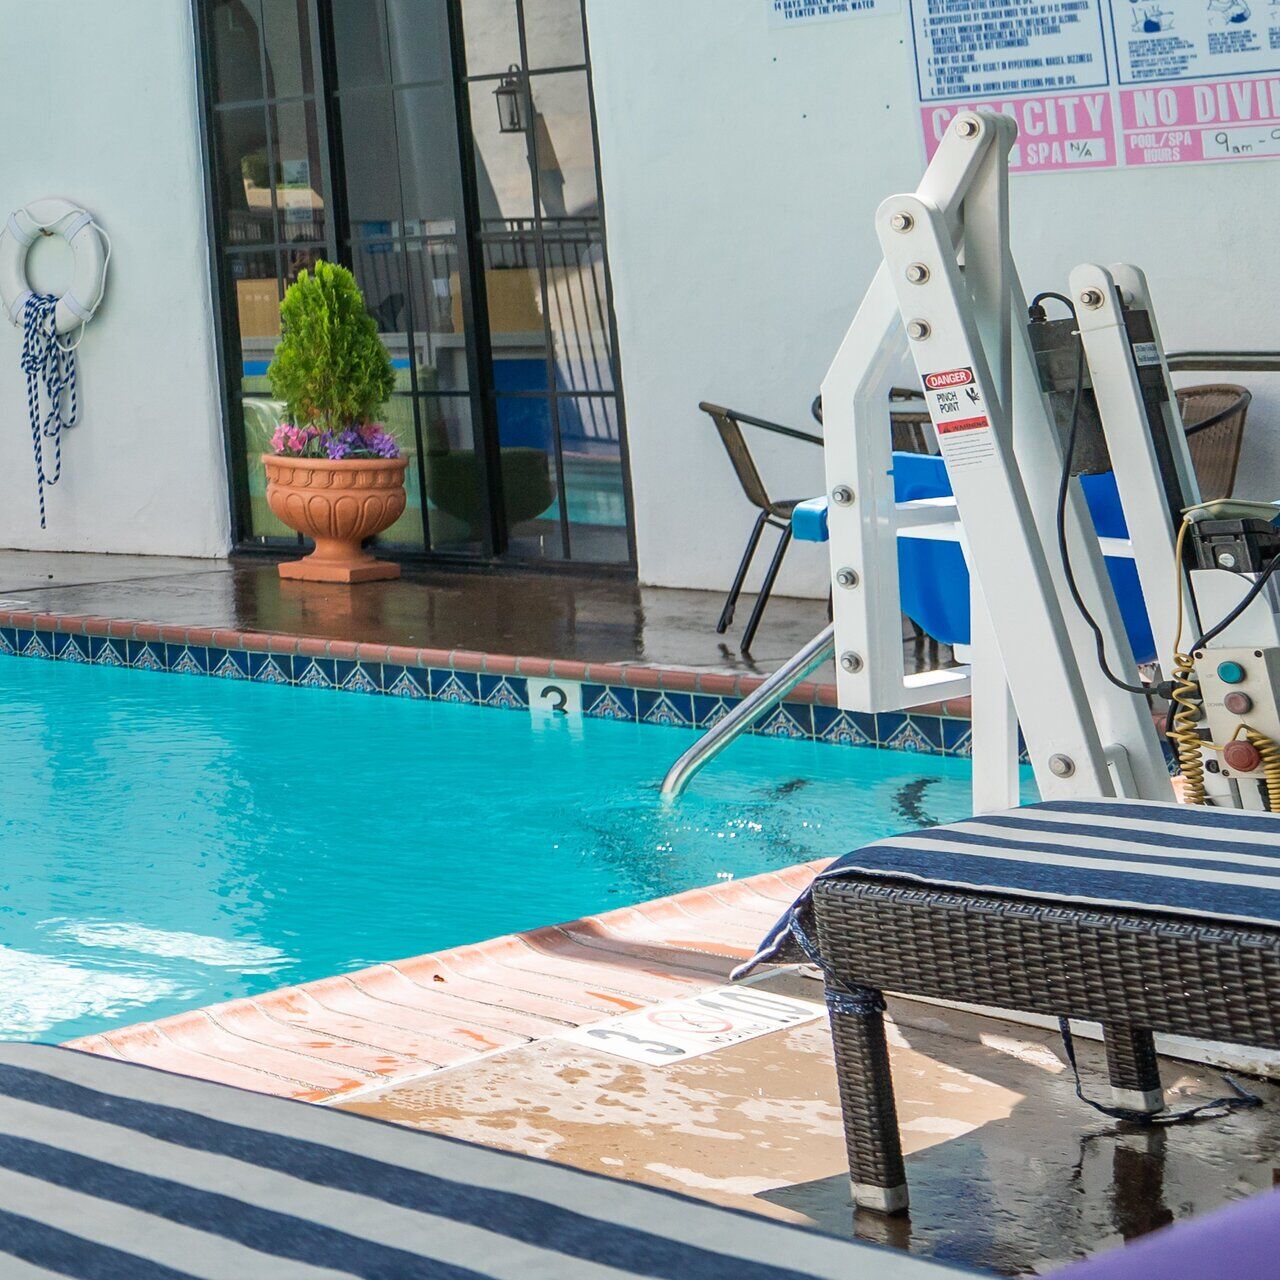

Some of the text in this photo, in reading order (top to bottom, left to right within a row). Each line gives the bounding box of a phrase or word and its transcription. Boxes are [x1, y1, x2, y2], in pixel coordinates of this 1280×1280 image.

[1133, 88, 1178, 128] NO
[1130, 131, 1192, 149] POOL/SPA
[1027, 141, 1063, 165] SPA
[1070, 141, 1092, 157] N/A
[1144, 147, 1180, 163] HOURS
[930, 371, 967, 387] DANGER
[936, 391, 958, 403] PINCH
[939, 401, 960, 413] POINT
